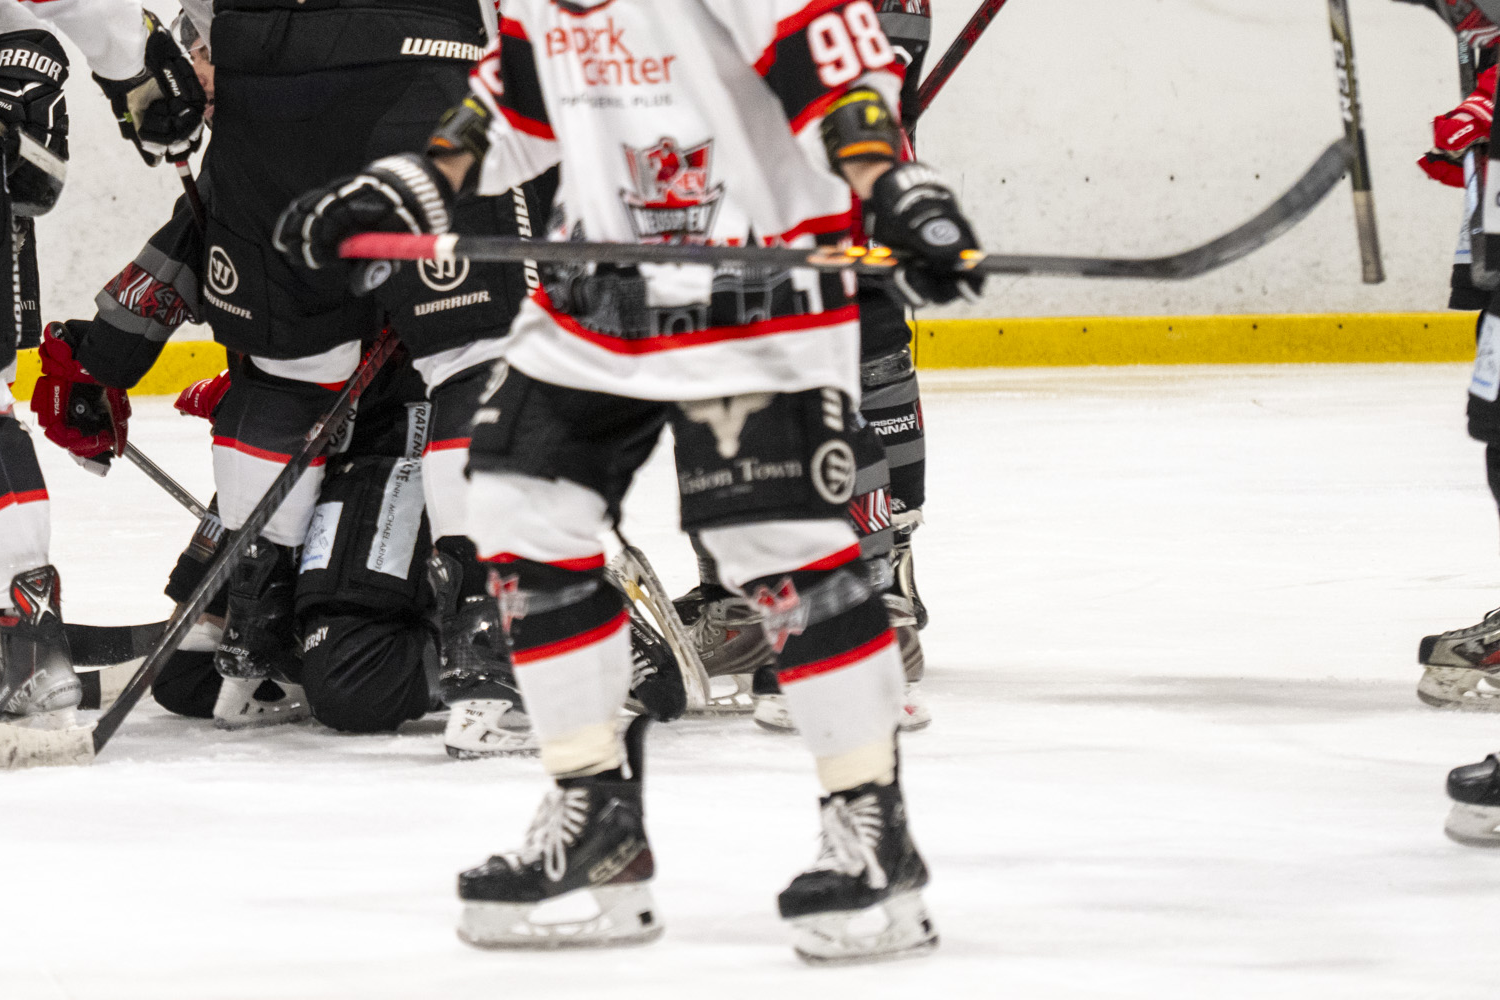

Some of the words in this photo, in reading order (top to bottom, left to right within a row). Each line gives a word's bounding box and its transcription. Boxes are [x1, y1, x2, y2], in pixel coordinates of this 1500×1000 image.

[807, 0, 897, 88] 98
[163, 68, 181, 98] ALPHA
[414, 289, 491, 316] WARRIOR
[53, 385, 61, 416] TACKS
